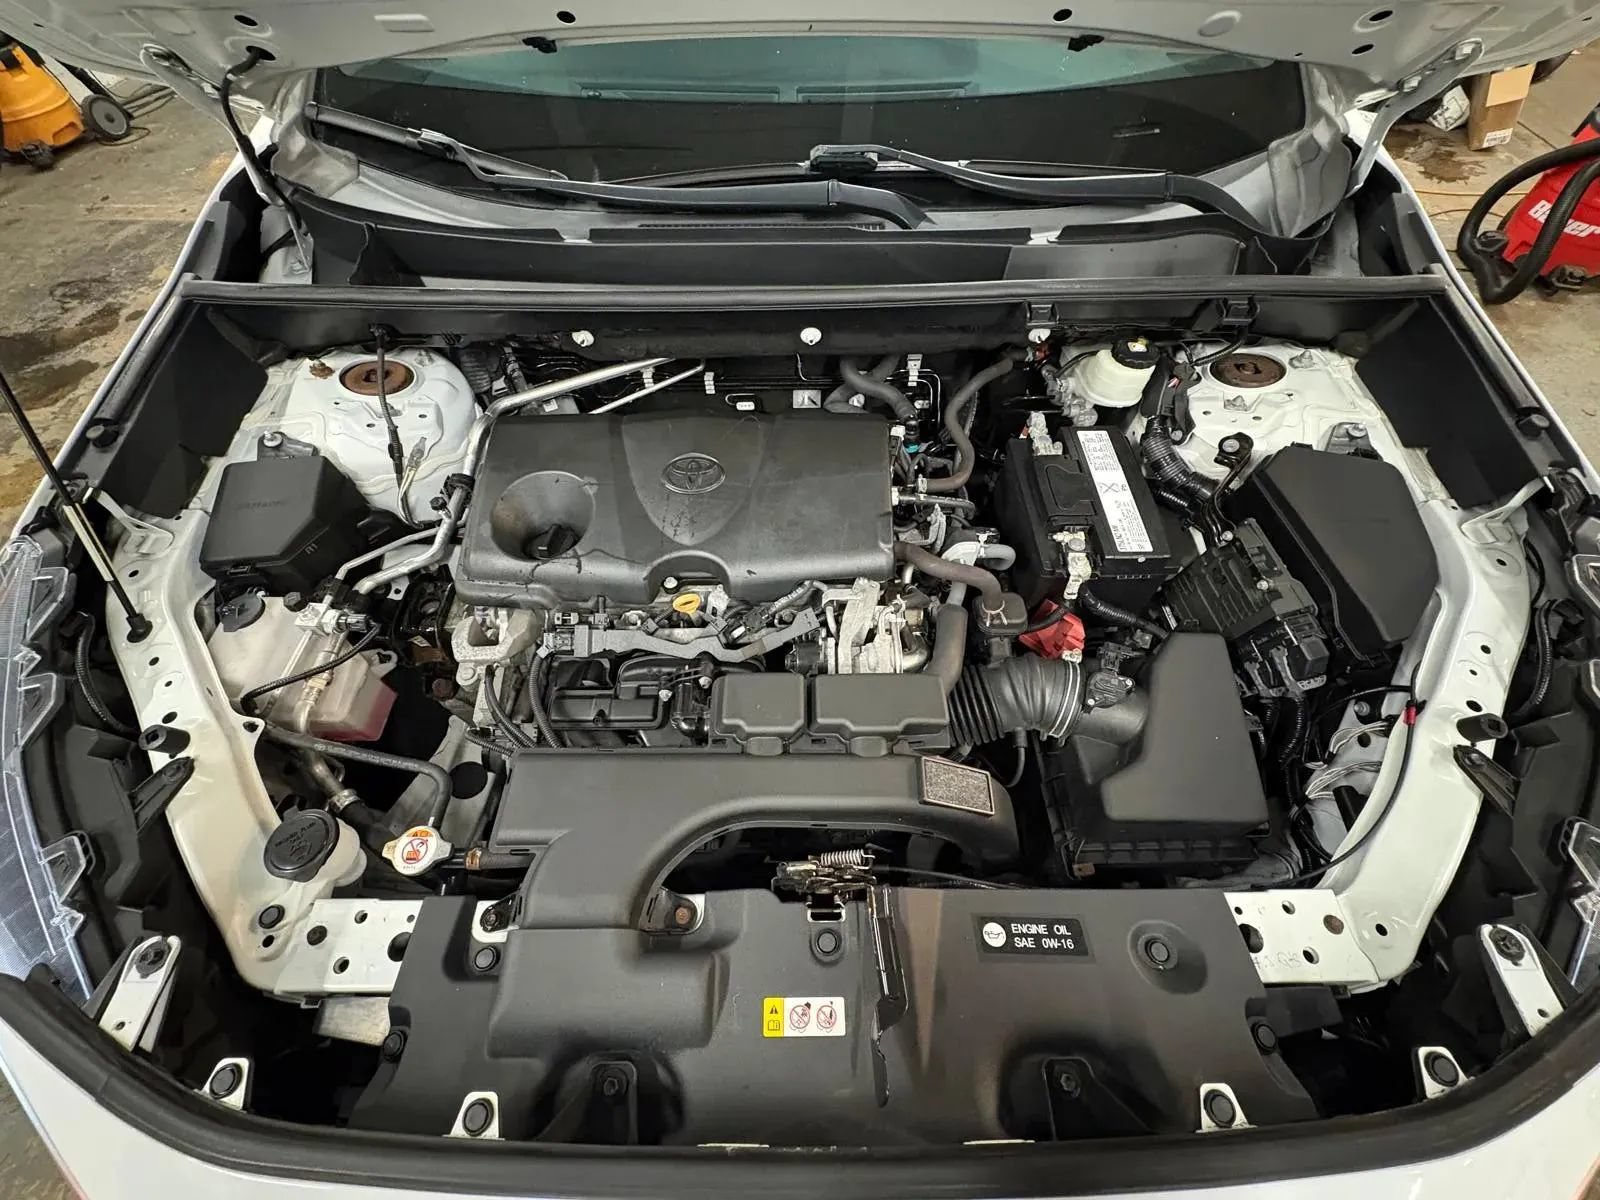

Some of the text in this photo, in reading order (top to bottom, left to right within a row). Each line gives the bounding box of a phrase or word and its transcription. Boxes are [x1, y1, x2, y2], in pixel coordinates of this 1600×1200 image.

[1528, 200, 1600, 237] Ber
[1011, 923, 1072, 936] ENGINE OIL
[1014, 937, 1075, 949] SAE 0W-16
